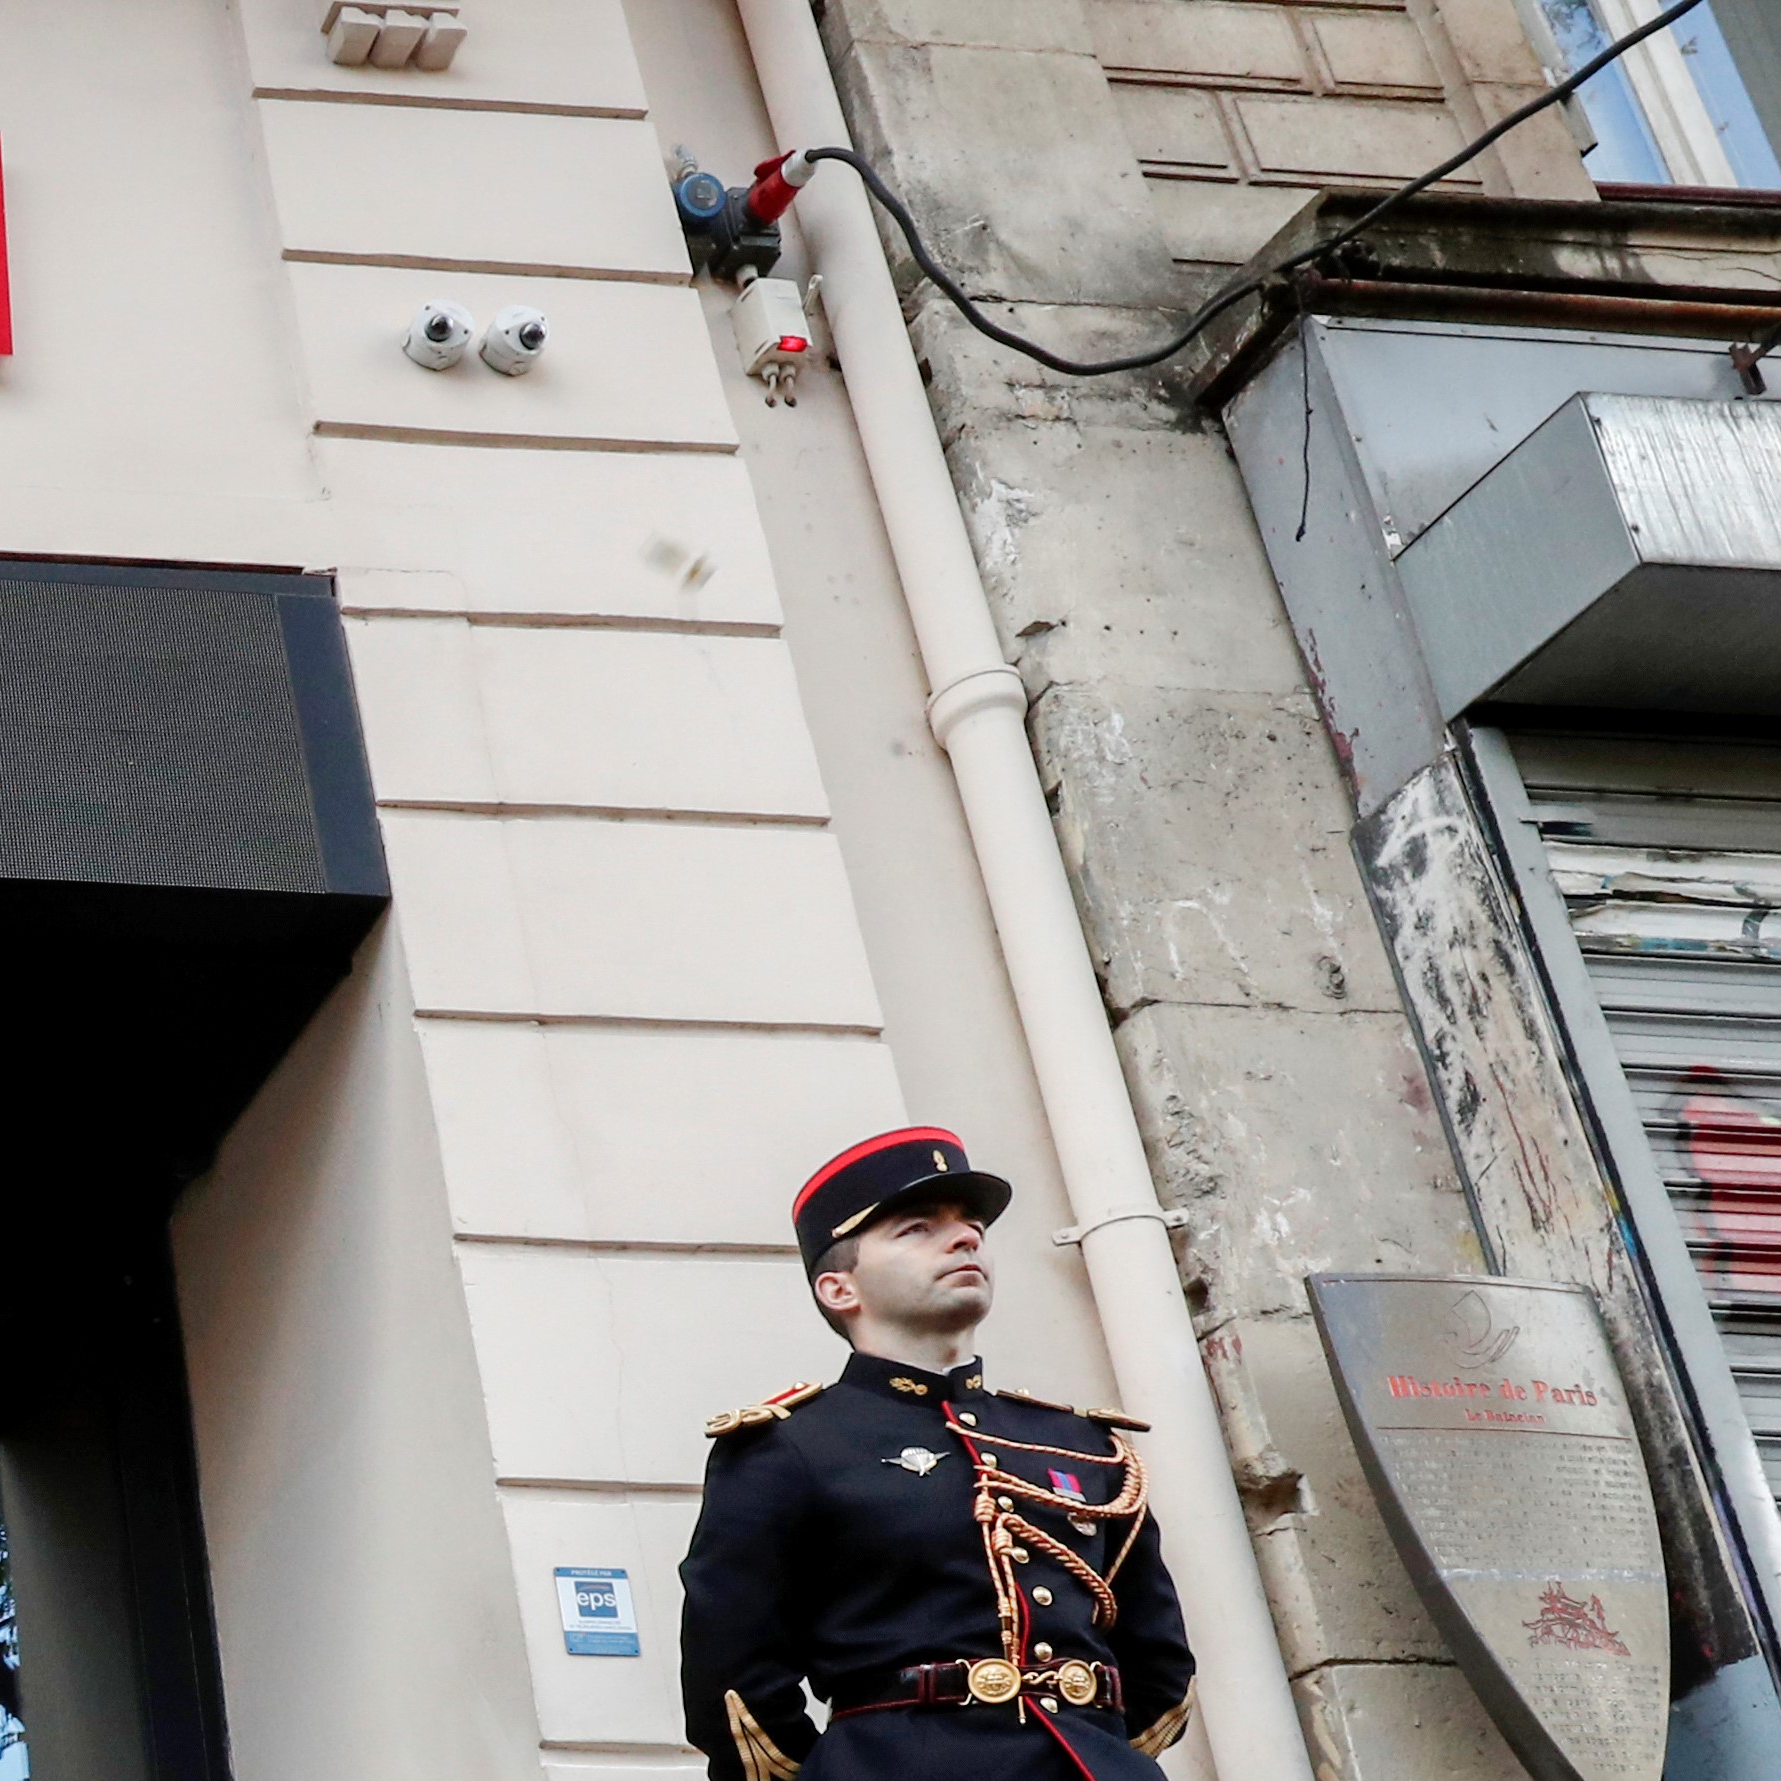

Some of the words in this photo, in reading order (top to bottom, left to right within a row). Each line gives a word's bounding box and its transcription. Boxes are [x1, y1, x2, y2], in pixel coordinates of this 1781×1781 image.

[1387, 1375, 1491, 1398] Histoire
[1499, 1378, 1527, 1400] de
[1531, 1379, 1599, 1407] Paris
[1464, 1408, 1482, 1422] Le
[1484, 1409, 1547, 1424] Bataclan
[577, 1592, 616, 1611] eps
